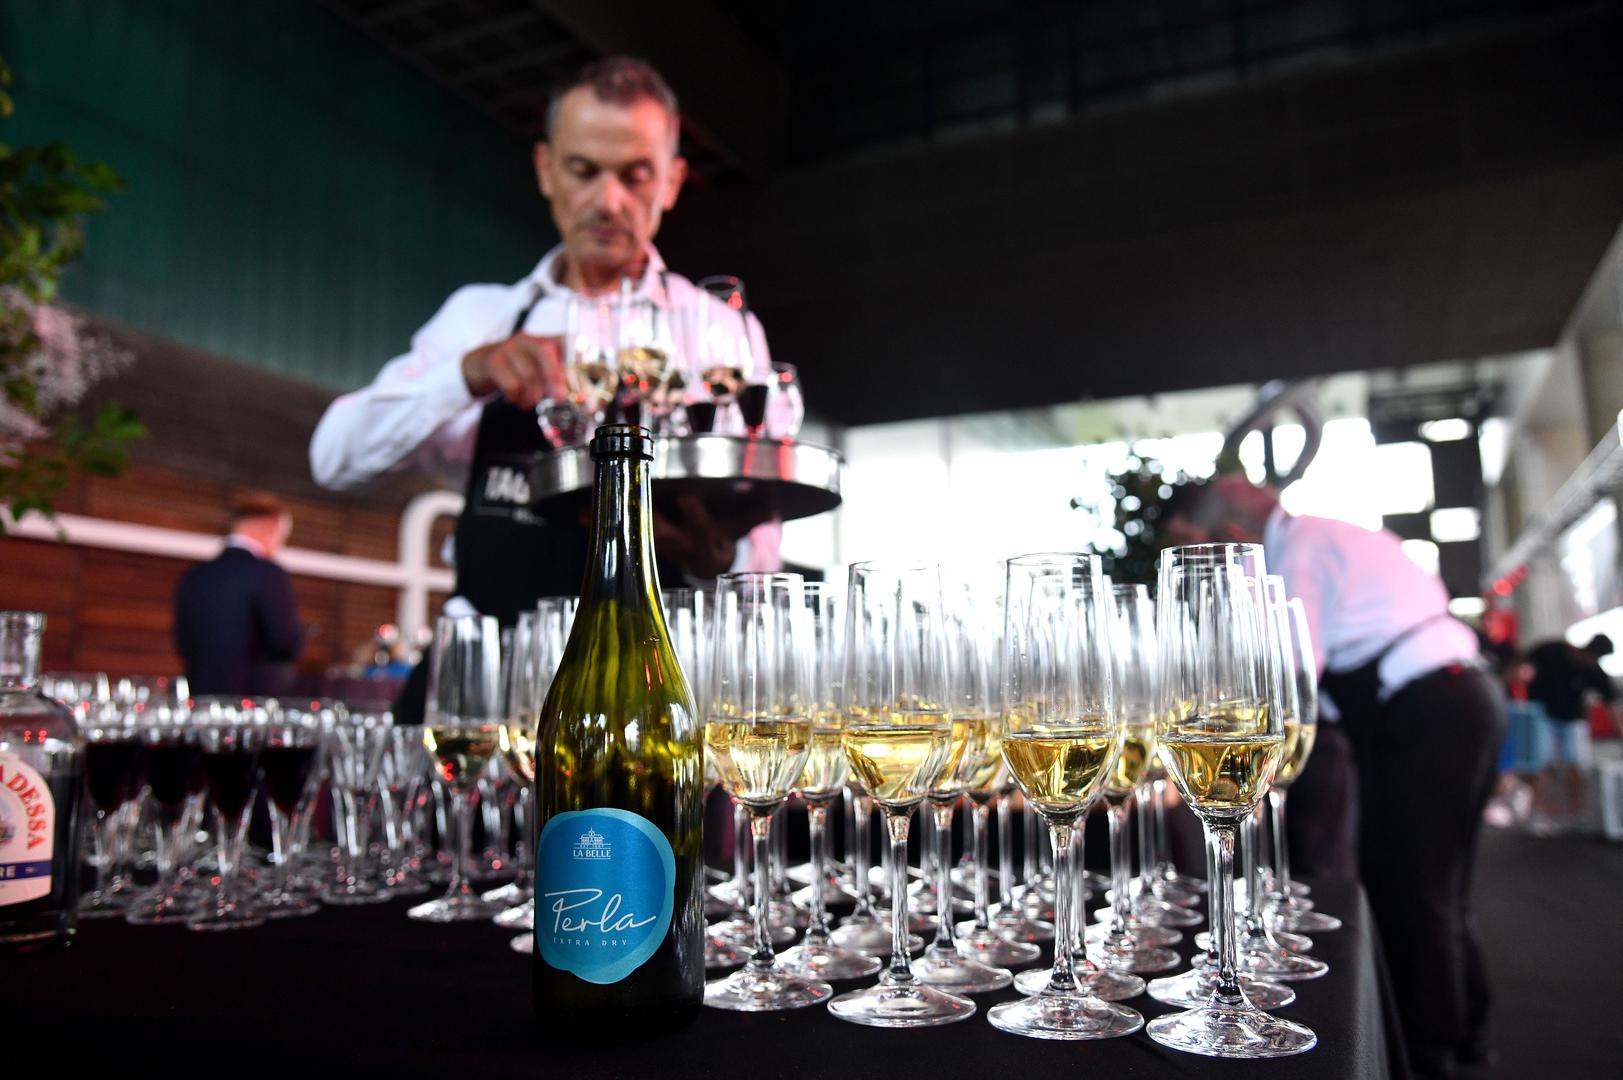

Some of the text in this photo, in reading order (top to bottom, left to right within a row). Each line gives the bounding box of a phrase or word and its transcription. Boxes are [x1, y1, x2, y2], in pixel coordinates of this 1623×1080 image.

[0, 764, 47, 850] DESSA
[573, 849, 612, 858] LA BELLE
[544, 888, 657, 934] Perla
[553, 938, 590, 946] EXTRA
